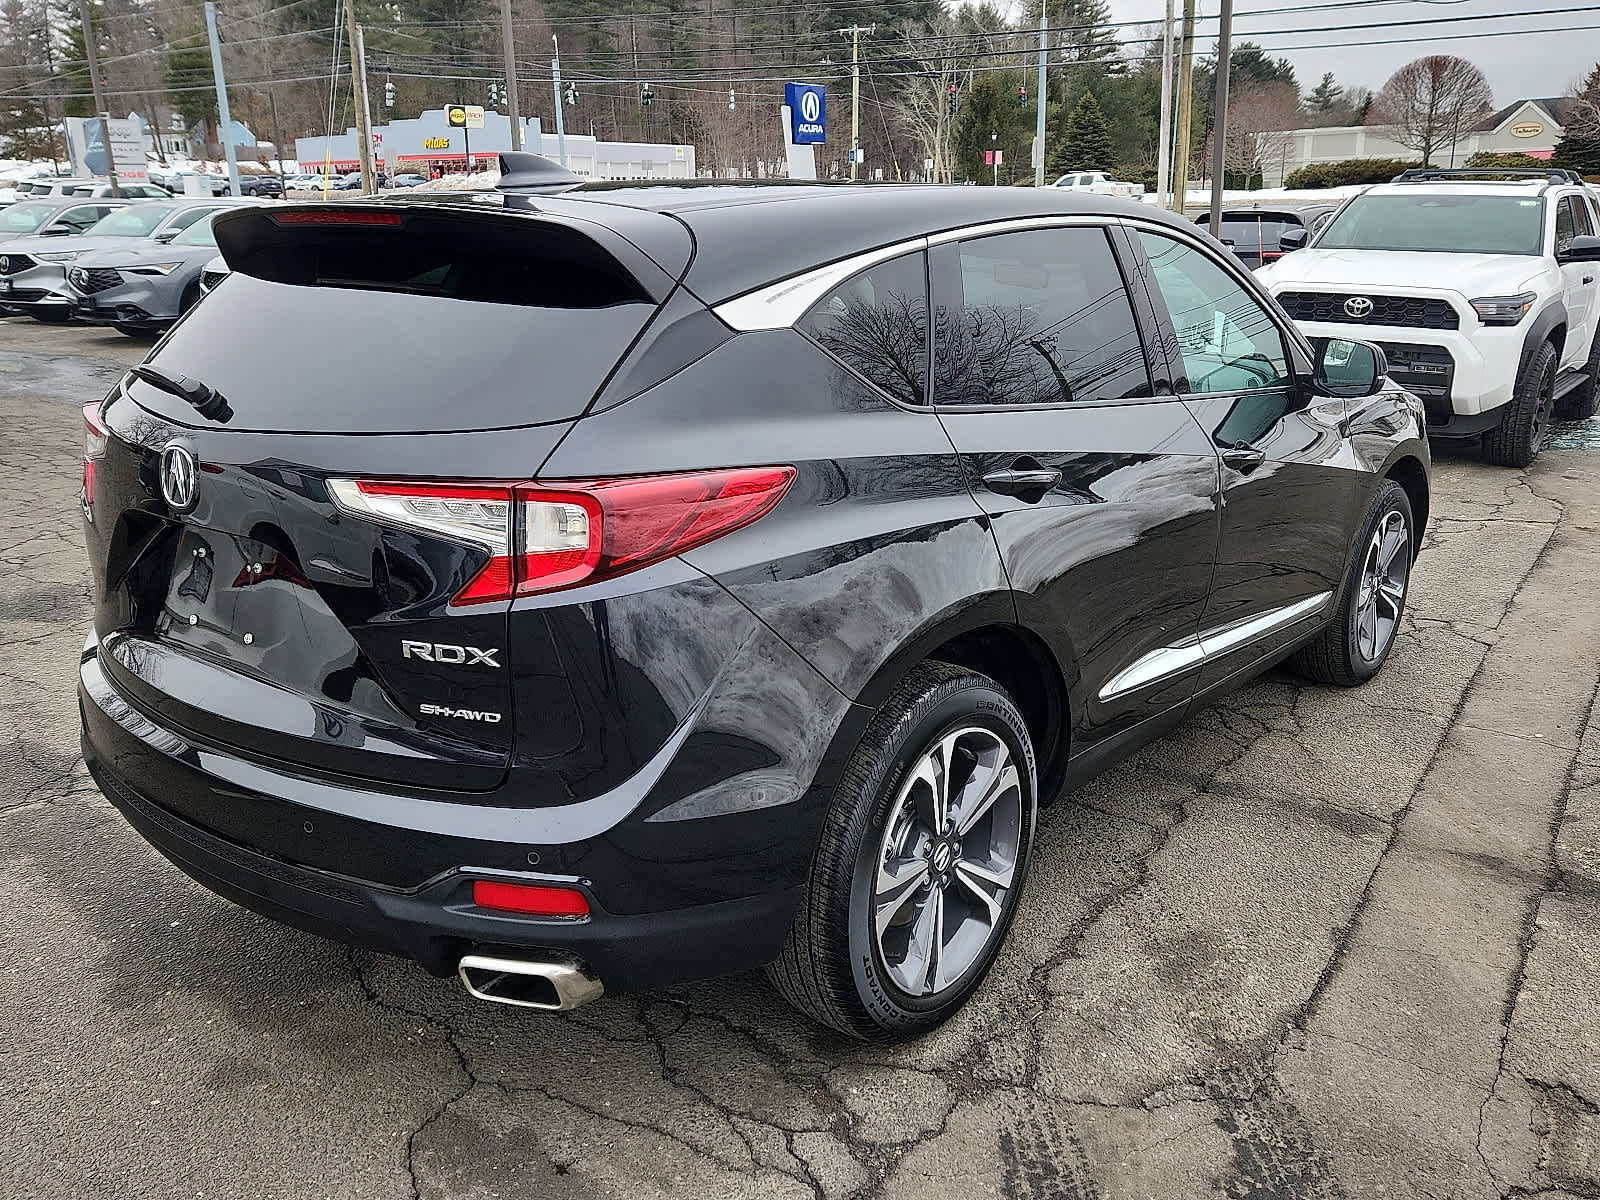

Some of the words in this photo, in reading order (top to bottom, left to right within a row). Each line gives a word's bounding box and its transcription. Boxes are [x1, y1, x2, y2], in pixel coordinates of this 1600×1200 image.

[799, 123, 823, 133] ACURA
[401, 639, 501, 668] RDX
[419, 703, 502, 723] SH-AWD
[872, 767, 903, 828] Continental
